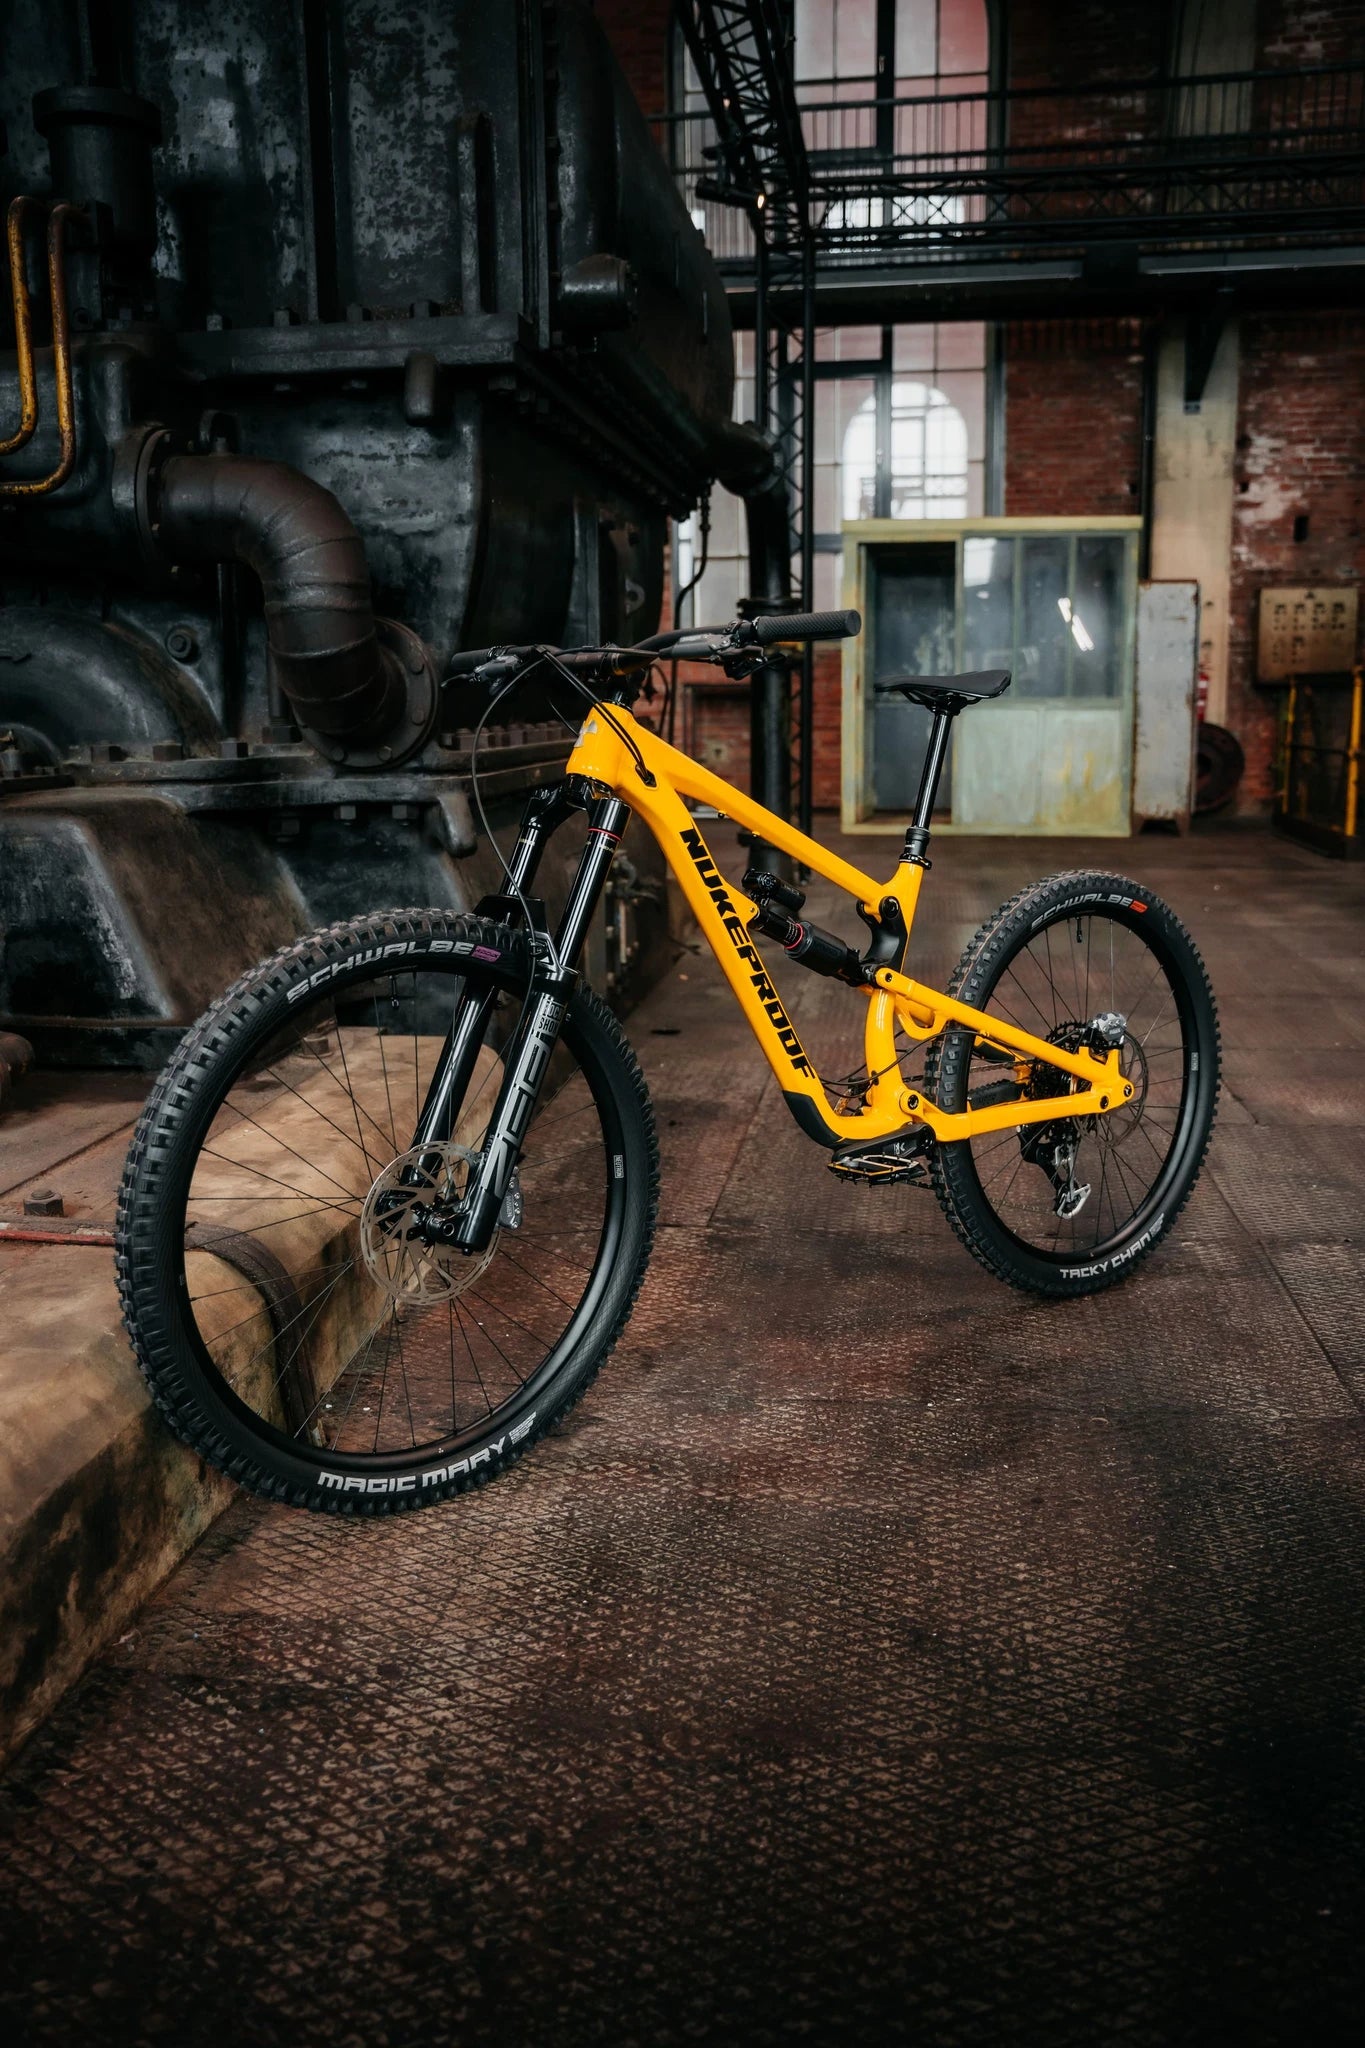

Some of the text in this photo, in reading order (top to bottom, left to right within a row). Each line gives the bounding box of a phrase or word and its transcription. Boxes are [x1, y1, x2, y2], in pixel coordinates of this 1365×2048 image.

[1031, 893, 1133, 930] SCHWALBE
[287, 940, 474, 1004] SCHWALBE
[679, 820, 816, 1079] NUKEPROOF
[1060, 1232, 1151, 1279] TACKY CHAN
[317, 1436, 506, 1493] MAGIC MARY
